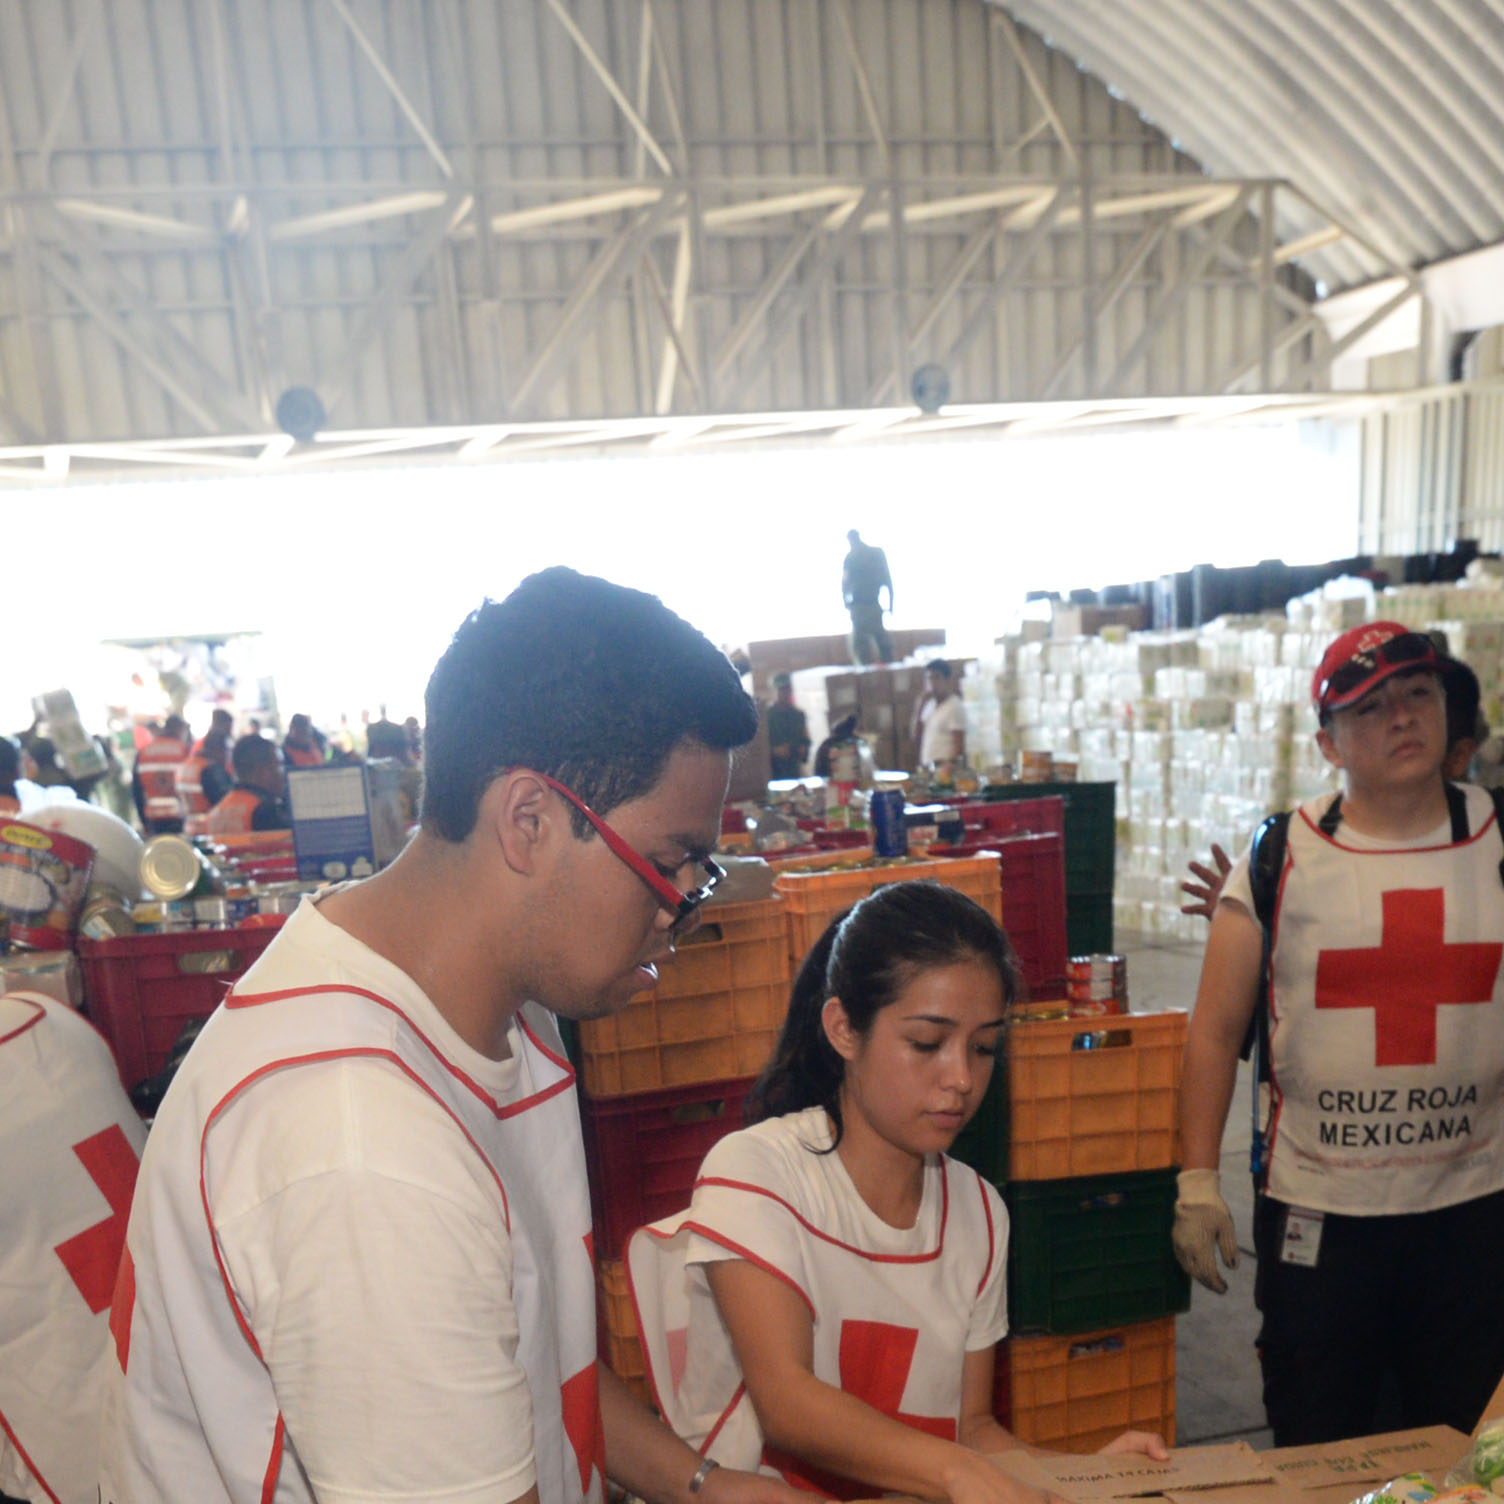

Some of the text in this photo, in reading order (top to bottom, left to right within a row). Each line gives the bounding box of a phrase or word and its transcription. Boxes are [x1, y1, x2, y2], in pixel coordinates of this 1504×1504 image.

[1318, 1084, 1478, 1114] CRUZ ROJA
[1319, 1115, 1472, 1147] MEXICANA
